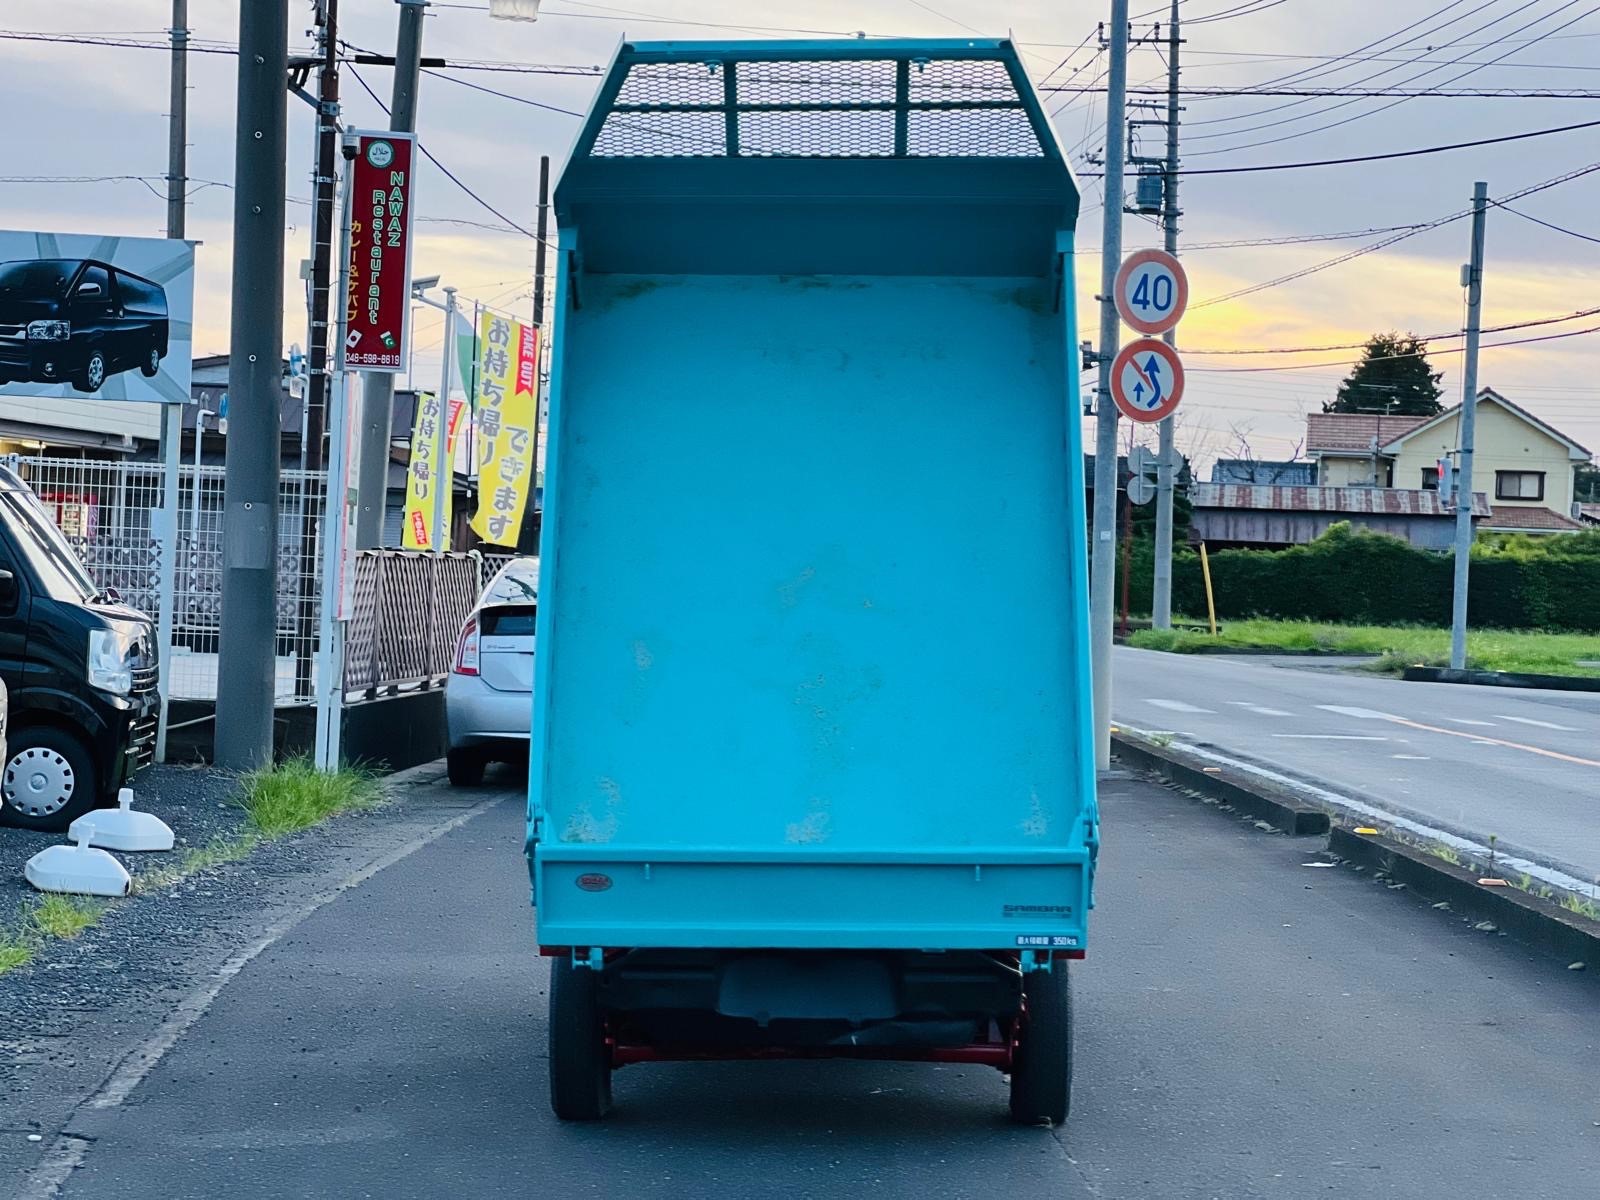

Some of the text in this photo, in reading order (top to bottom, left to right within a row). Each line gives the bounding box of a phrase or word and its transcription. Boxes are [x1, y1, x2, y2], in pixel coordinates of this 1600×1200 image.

[368, 189, 386, 325] Restaurant
[387, 171, 404, 247] NAWAZ
[1131, 273, 1172, 311] 40
[478, 318, 510, 466] お持ち帰り
[518, 326, 535, 390] TAKE OUT
[412, 398, 440, 500] お持ち帰り
[488, 425, 530, 541] できます
